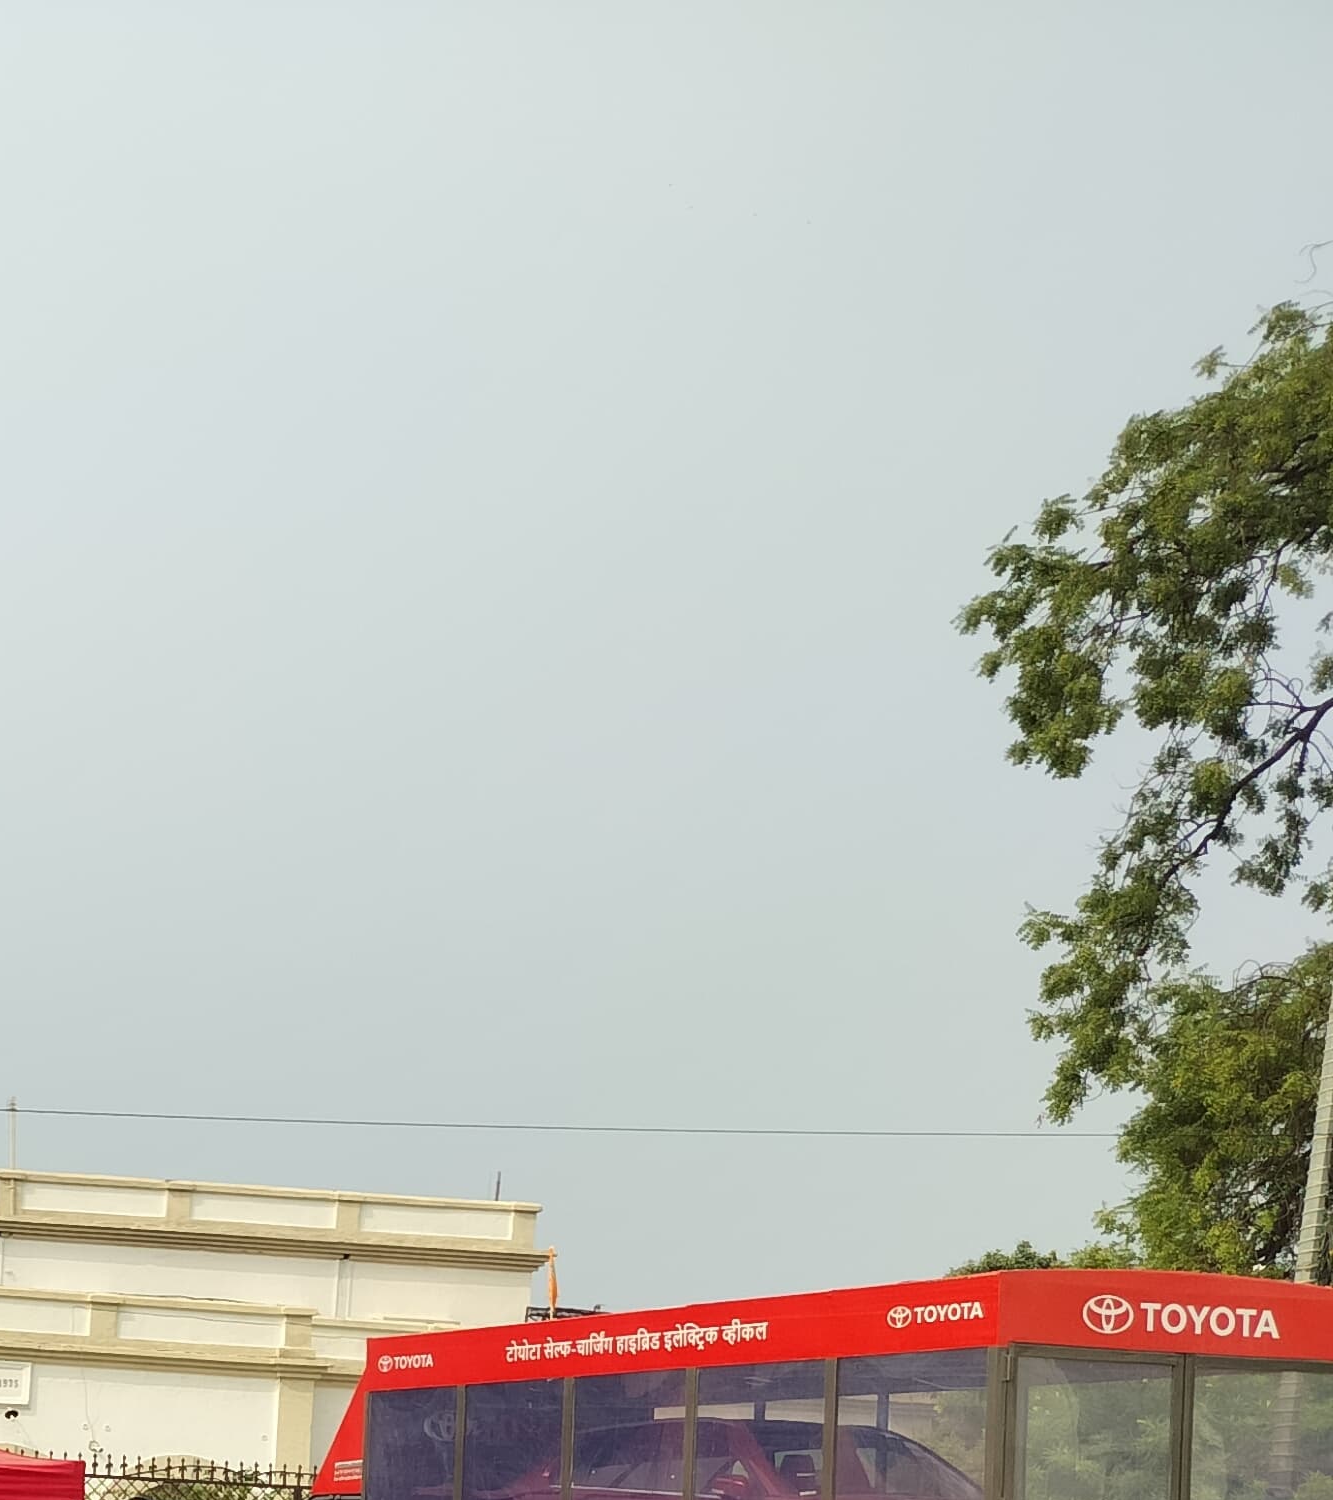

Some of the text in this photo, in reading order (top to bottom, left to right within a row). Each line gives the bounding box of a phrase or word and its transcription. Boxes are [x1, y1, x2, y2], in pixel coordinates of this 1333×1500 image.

[914, 1301, 984, 1324] TOYOTA
[1140, 1302, 1279, 1339] TOYOTA
[506, 1319, 769, 1364] टोयोटा सेल्फ-चार्जिंग हाइब्रिड इलेक्ट्रिक व्हीकल
[394, 1353, 434, 1369] TOYOTA
